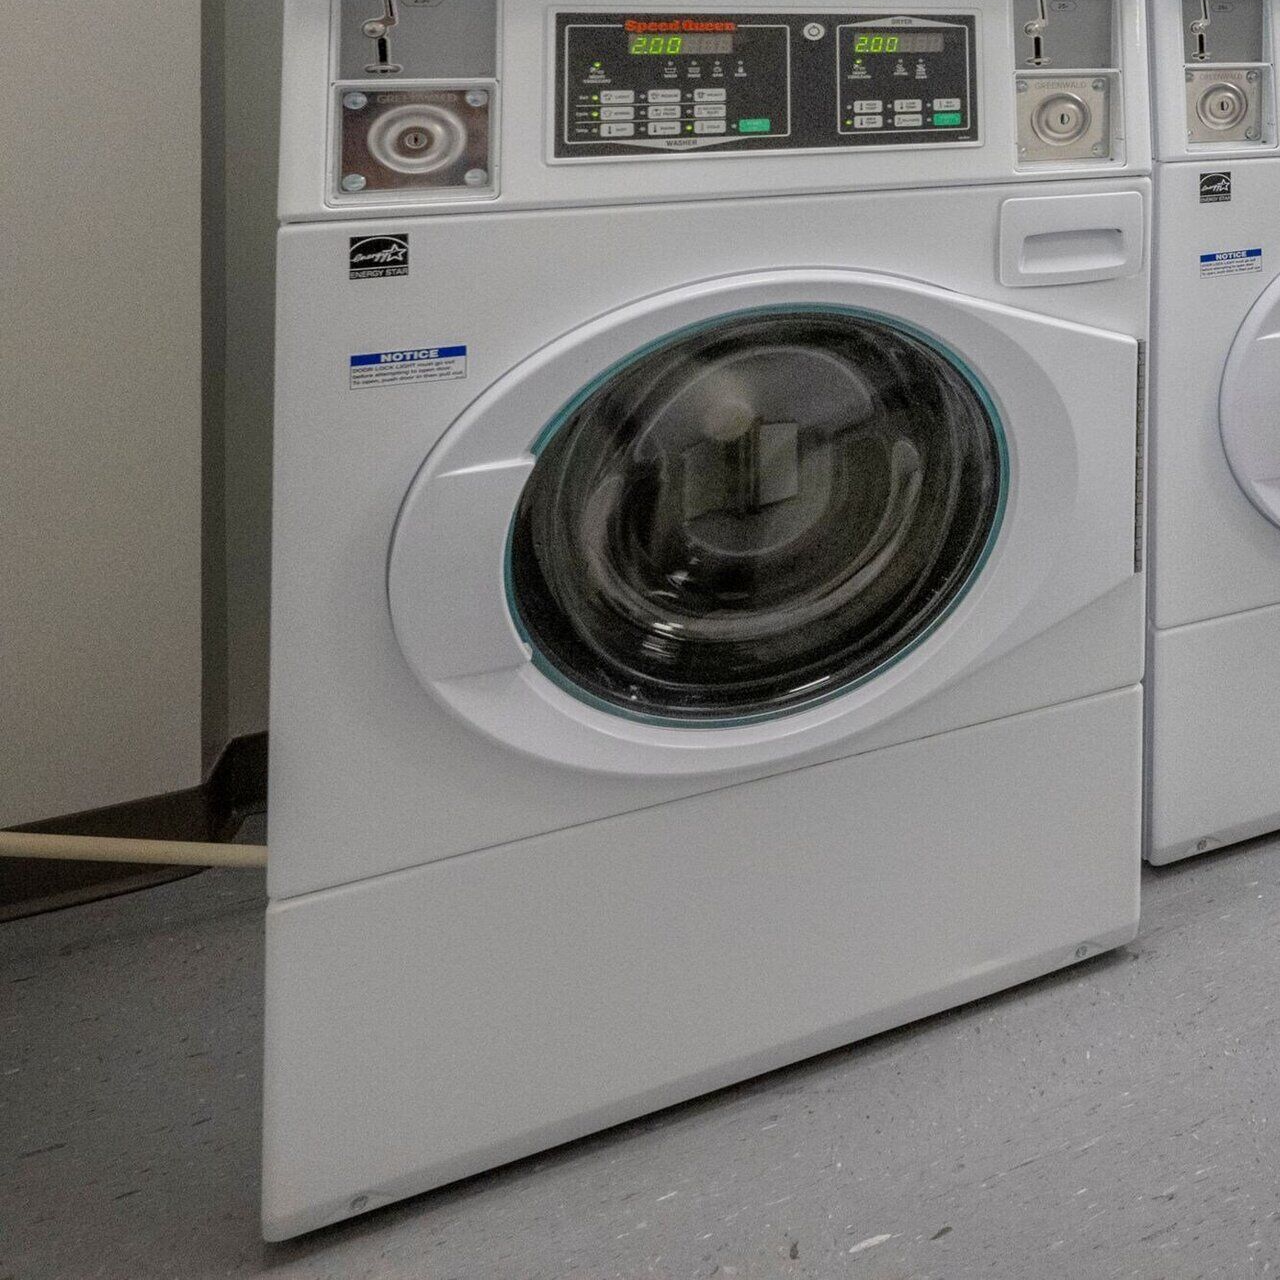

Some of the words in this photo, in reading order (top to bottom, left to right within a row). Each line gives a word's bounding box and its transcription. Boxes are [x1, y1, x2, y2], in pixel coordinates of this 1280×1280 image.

[625, 20, 679, 33] Speed
[683, 20, 736, 31] Queen
[665, 139, 698, 147] WASHER
[1215, 250, 1247, 260] NOTICE
[350, 270, 385, 279] ENERGY
[380, 349, 440, 362] NOTICE
